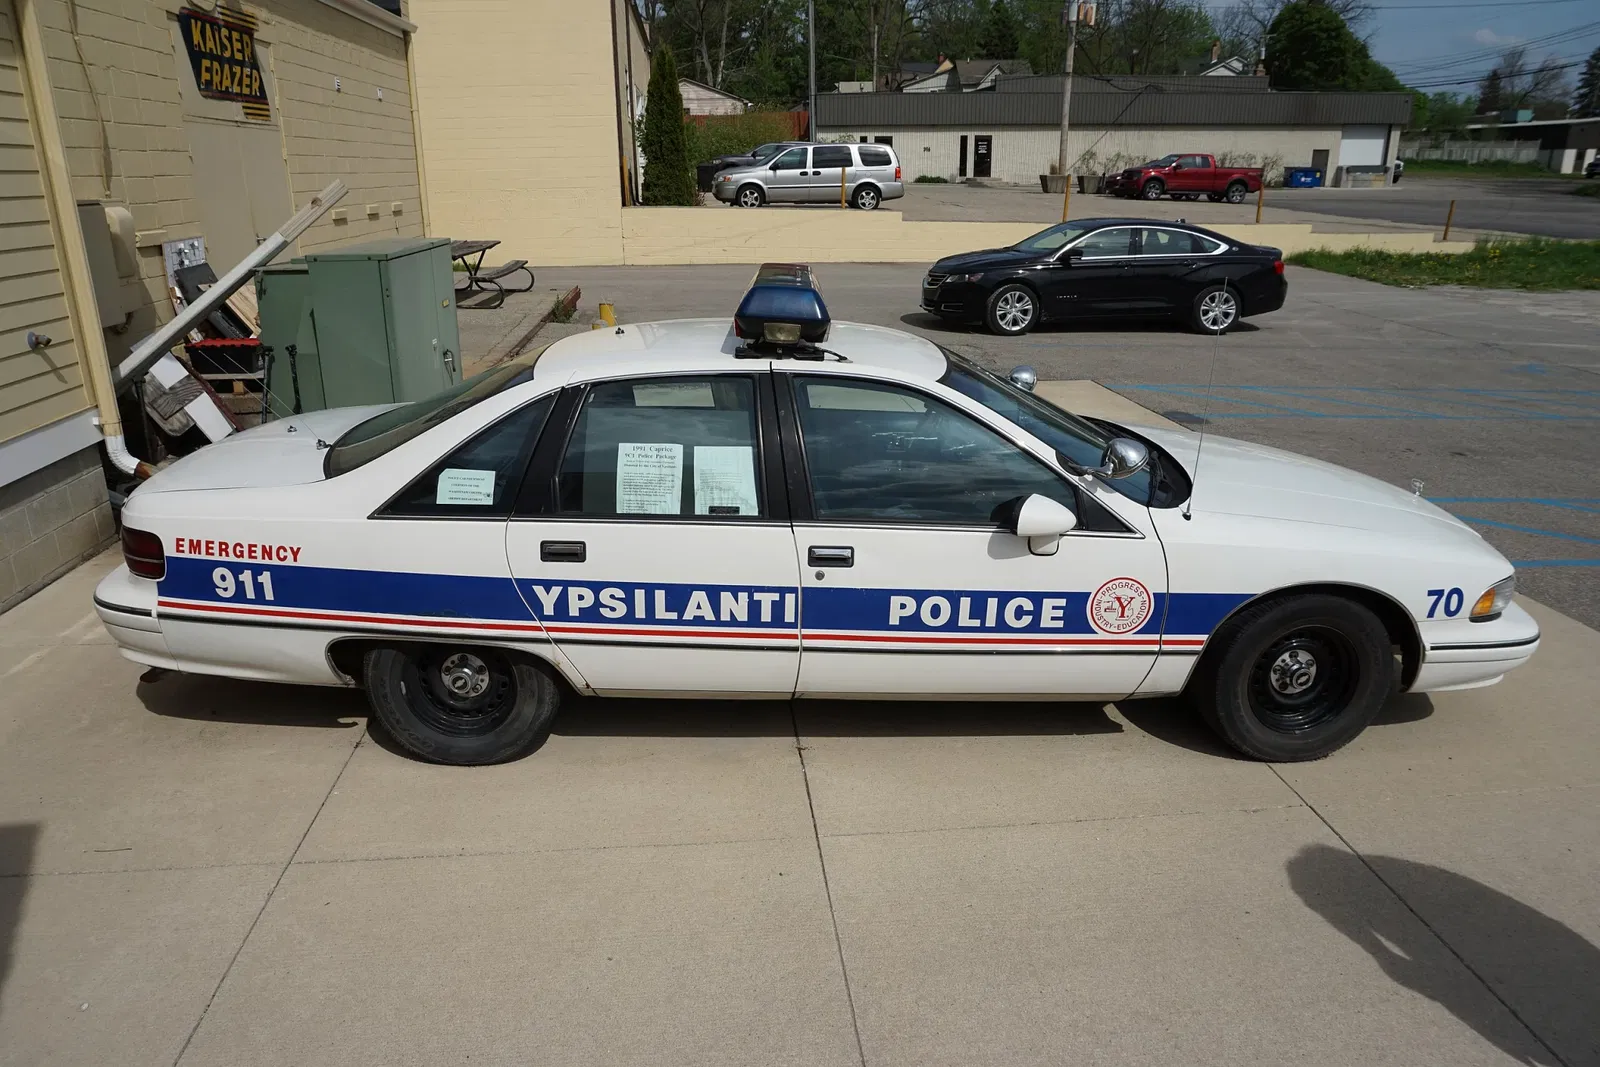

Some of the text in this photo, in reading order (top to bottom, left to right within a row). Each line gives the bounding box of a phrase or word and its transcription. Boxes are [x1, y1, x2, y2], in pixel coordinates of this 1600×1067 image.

[190, 19, 253, 63] KAISER
[201, 59, 260, 96] FRAZER
[649, 445, 674, 453] Caprice
[175, 537, 302, 563] EMERGENCY
[212, 566, 275, 601] 911
[1101, 581, 1145, 598] PROGRESS
[532, 585, 1067, 629] YPSILANTI POLICE
[1094, 598, 1114, 629] INDUSTRY
[1114, 596, 1135, 618] Y
[1117, 599, 1147, 630] EDUCATION
[1426, 587, 1464, 619] 70
